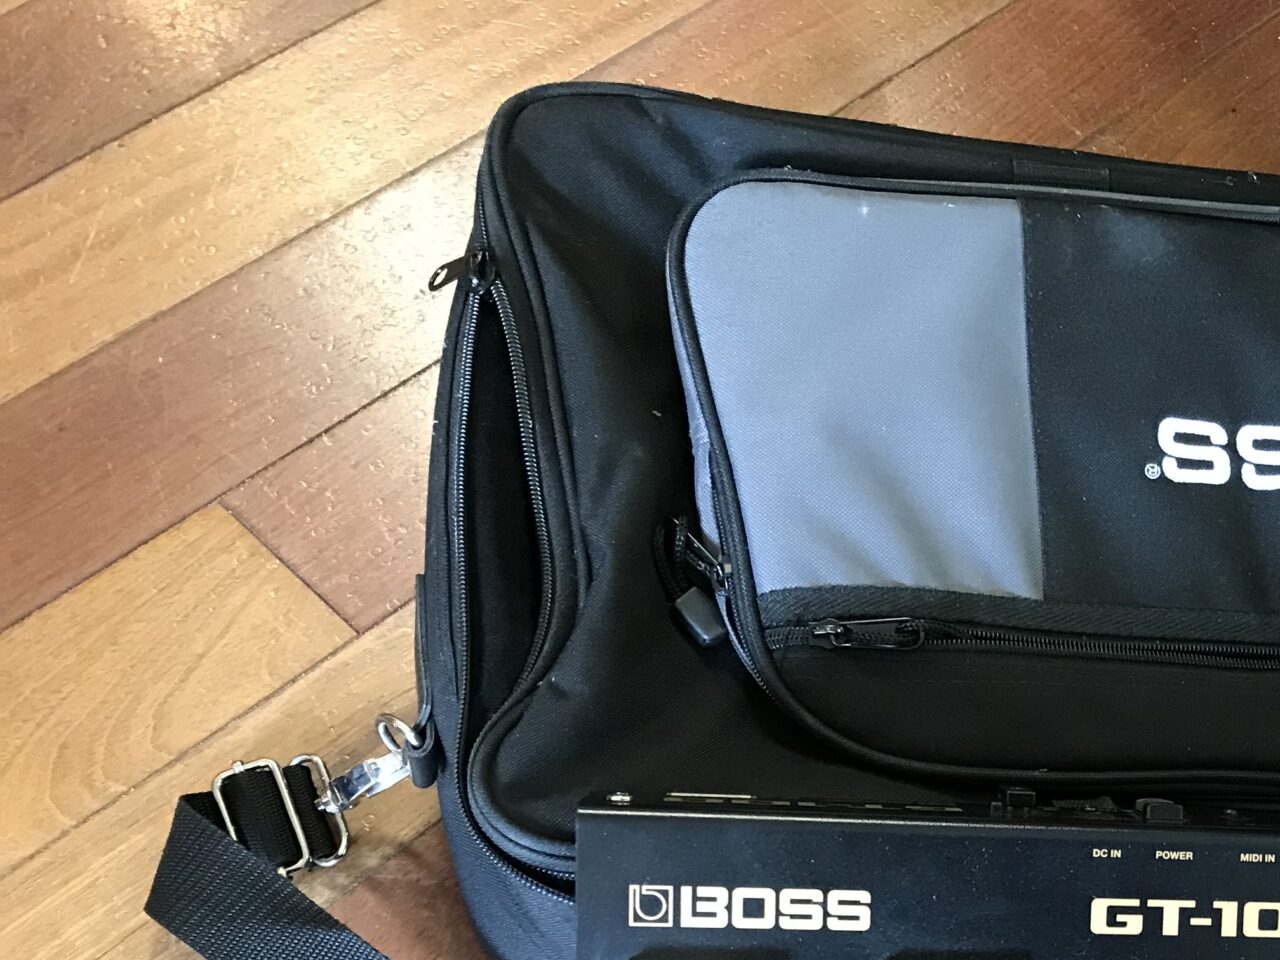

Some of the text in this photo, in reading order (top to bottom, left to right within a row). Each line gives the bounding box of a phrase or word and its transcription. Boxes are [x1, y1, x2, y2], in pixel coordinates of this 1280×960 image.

[1092, 848, 1122, 858] DC IN
[1155, 850, 1194, 861] POWER
[1240, 853, 1276, 863] MIDI IN
[679, 885, 872, 932] BOSS
